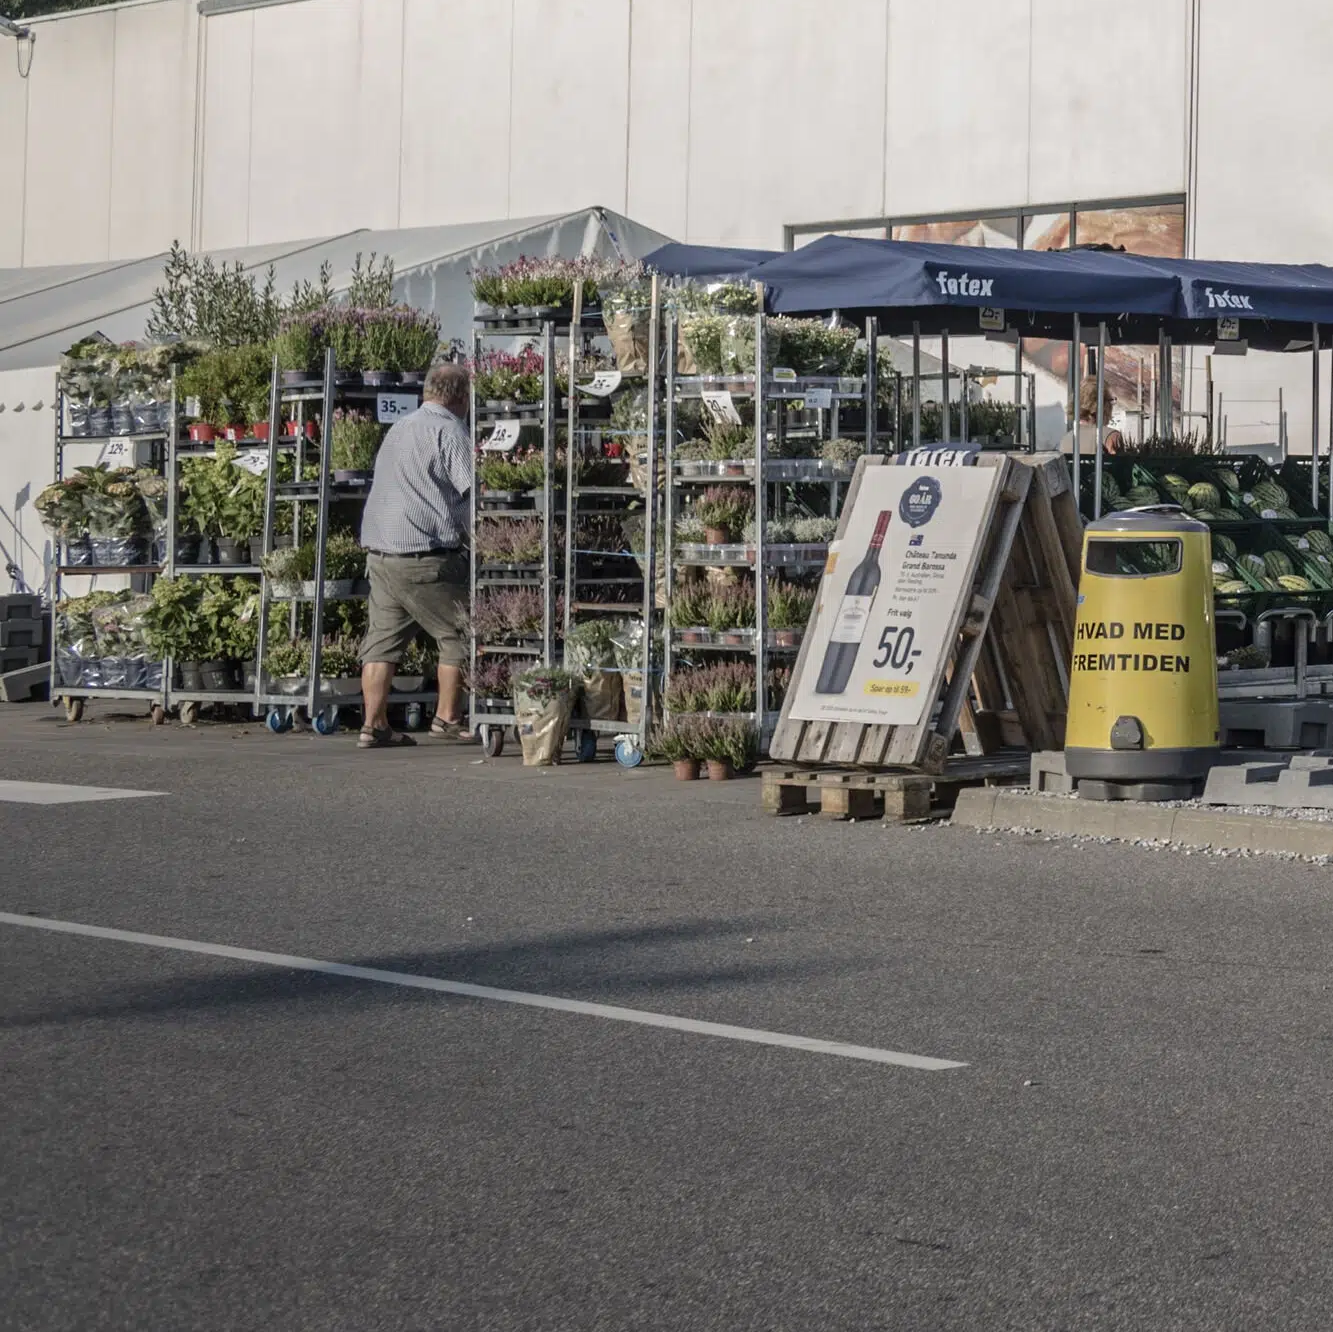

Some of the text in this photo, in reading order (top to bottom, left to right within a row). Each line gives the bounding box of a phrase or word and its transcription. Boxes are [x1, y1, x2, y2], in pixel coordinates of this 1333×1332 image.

[936, 271, 994, 297] føtex
[1205, 287, 1253, 310] føtex
[381, 399, 407, 414] 35,-
[887, 608, 899, 617] Frit
[1076, 622, 1185, 641] HVAD MED
[873, 626, 922, 675] 50,-
[1073, 653, 1190, 673] FREMTIDEN
